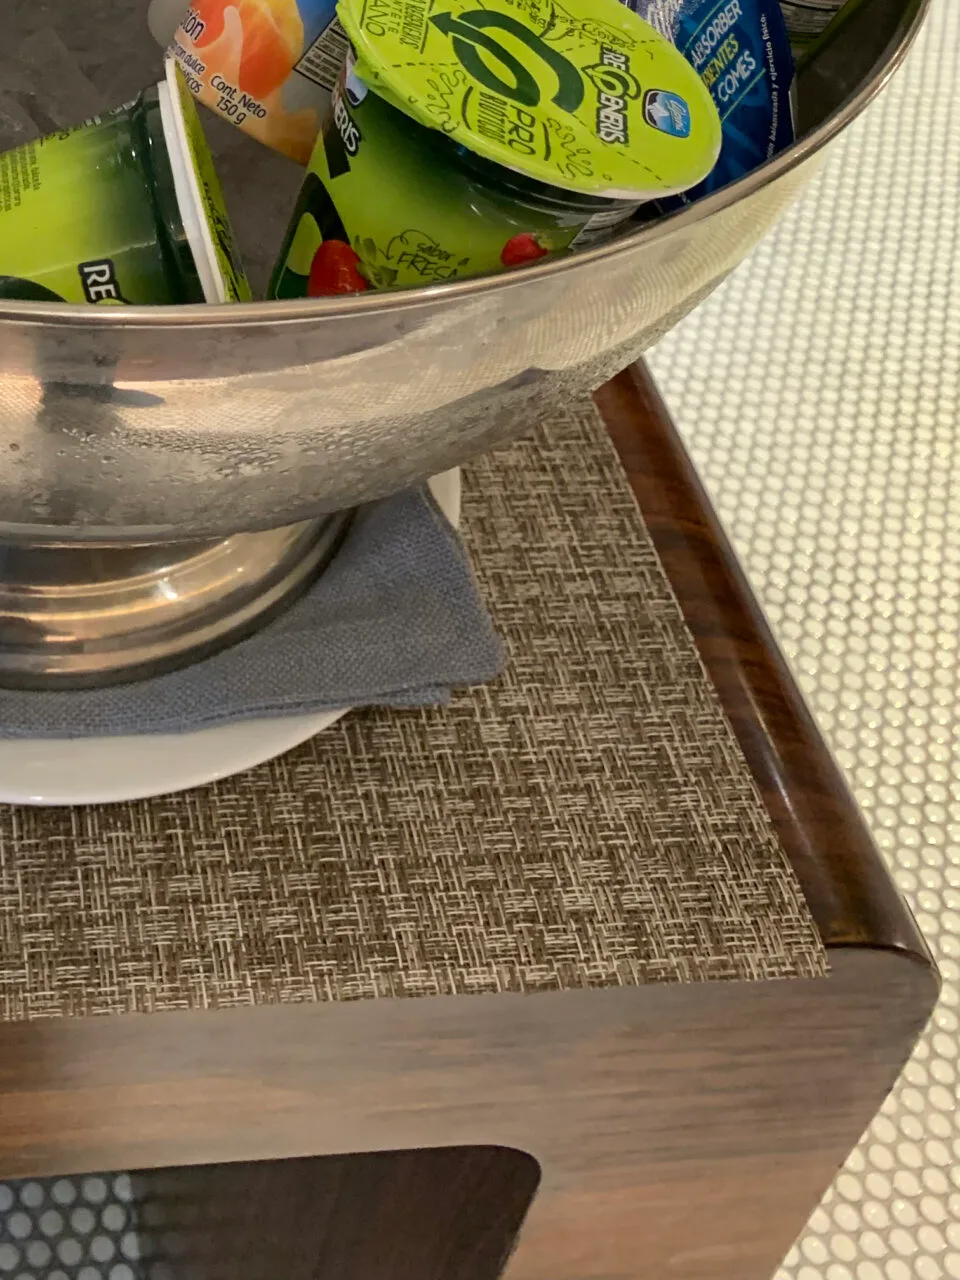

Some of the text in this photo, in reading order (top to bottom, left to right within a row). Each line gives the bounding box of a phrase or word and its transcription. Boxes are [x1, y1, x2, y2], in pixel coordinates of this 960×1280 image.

[717, 50, 756, 102] COMES
[765, 40, 777, 82] ejercicio
[210, 74, 236, 101] Cont.
[237, 93, 267, 119] Neto
[216, 94, 246, 126] 150 g
[477, 91, 509, 145] BIÓTICOS
[582, 44, 642, 145] REGENERIS
[507, 104, 537, 156] PRO
